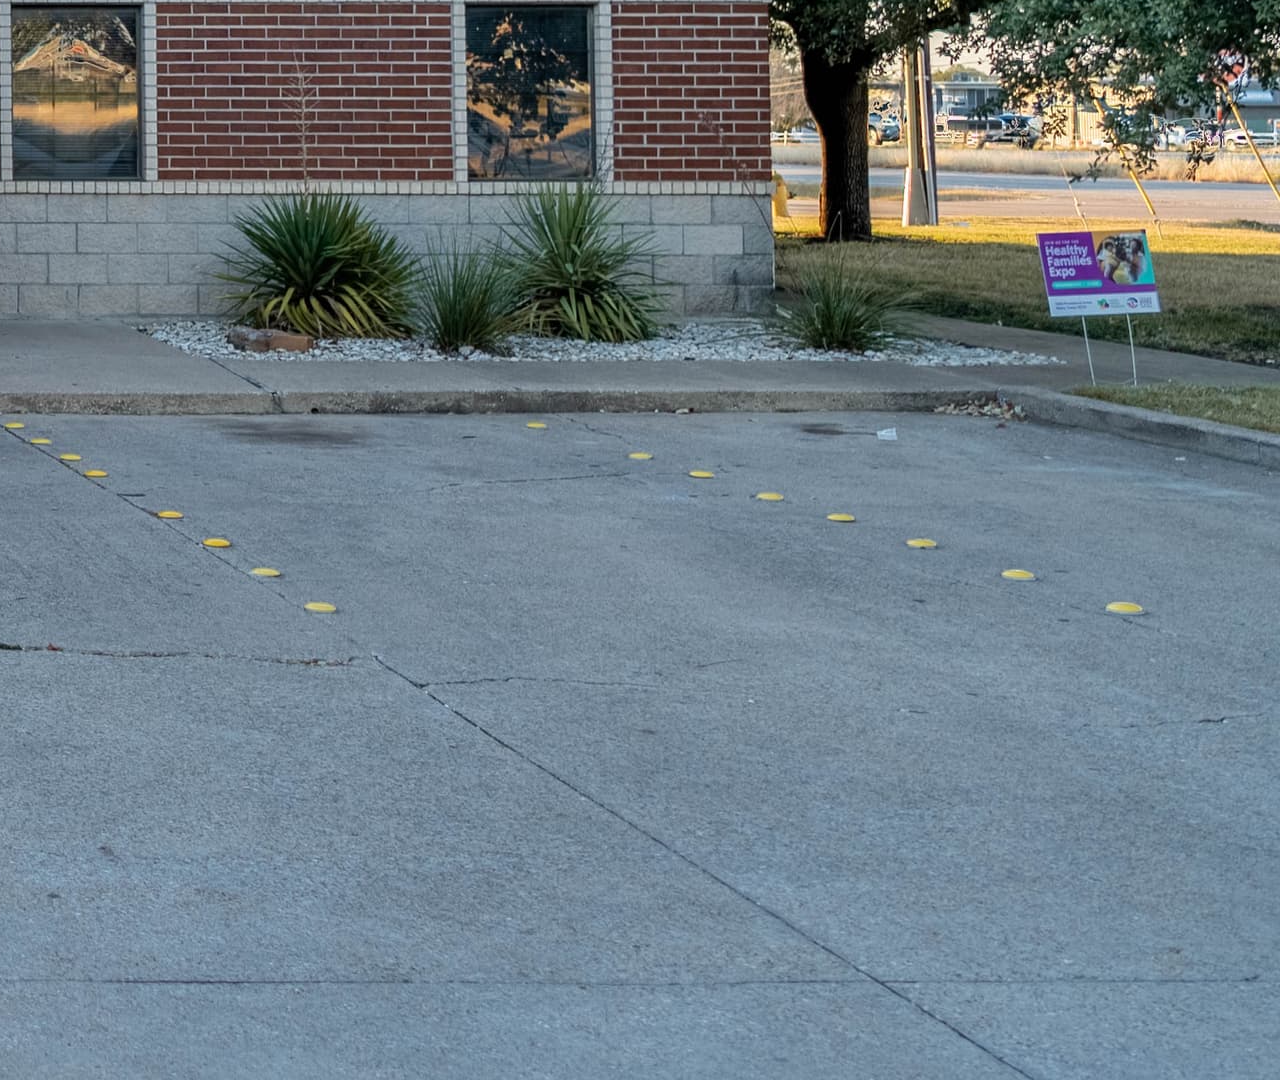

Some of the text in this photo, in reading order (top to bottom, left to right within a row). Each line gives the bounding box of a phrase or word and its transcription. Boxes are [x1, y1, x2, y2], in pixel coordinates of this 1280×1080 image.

[1045, 244, 1088, 257] Healthy
[1047, 255, 1092, 266] Families
[1049, 266, 1076, 279] Expo
